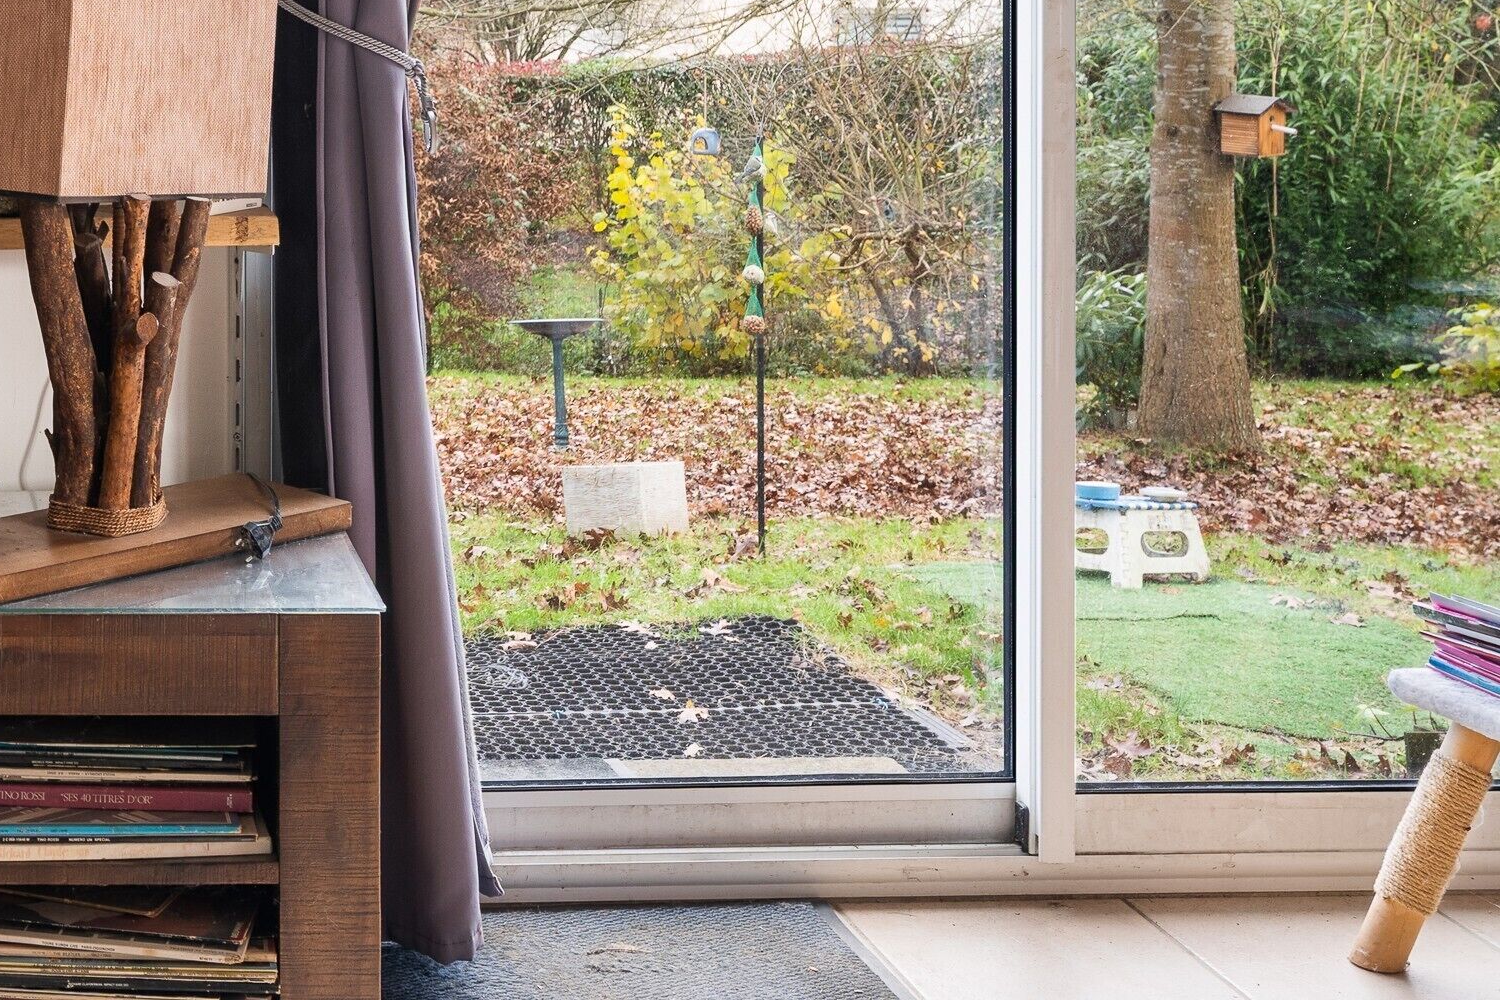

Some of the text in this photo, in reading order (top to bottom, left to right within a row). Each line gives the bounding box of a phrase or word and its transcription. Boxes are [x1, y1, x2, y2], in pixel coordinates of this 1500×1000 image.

[21, 791, 45, 801] ROSSI
[81, 793, 91, 803] 40
[94, 793, 125, 804] TITRES
